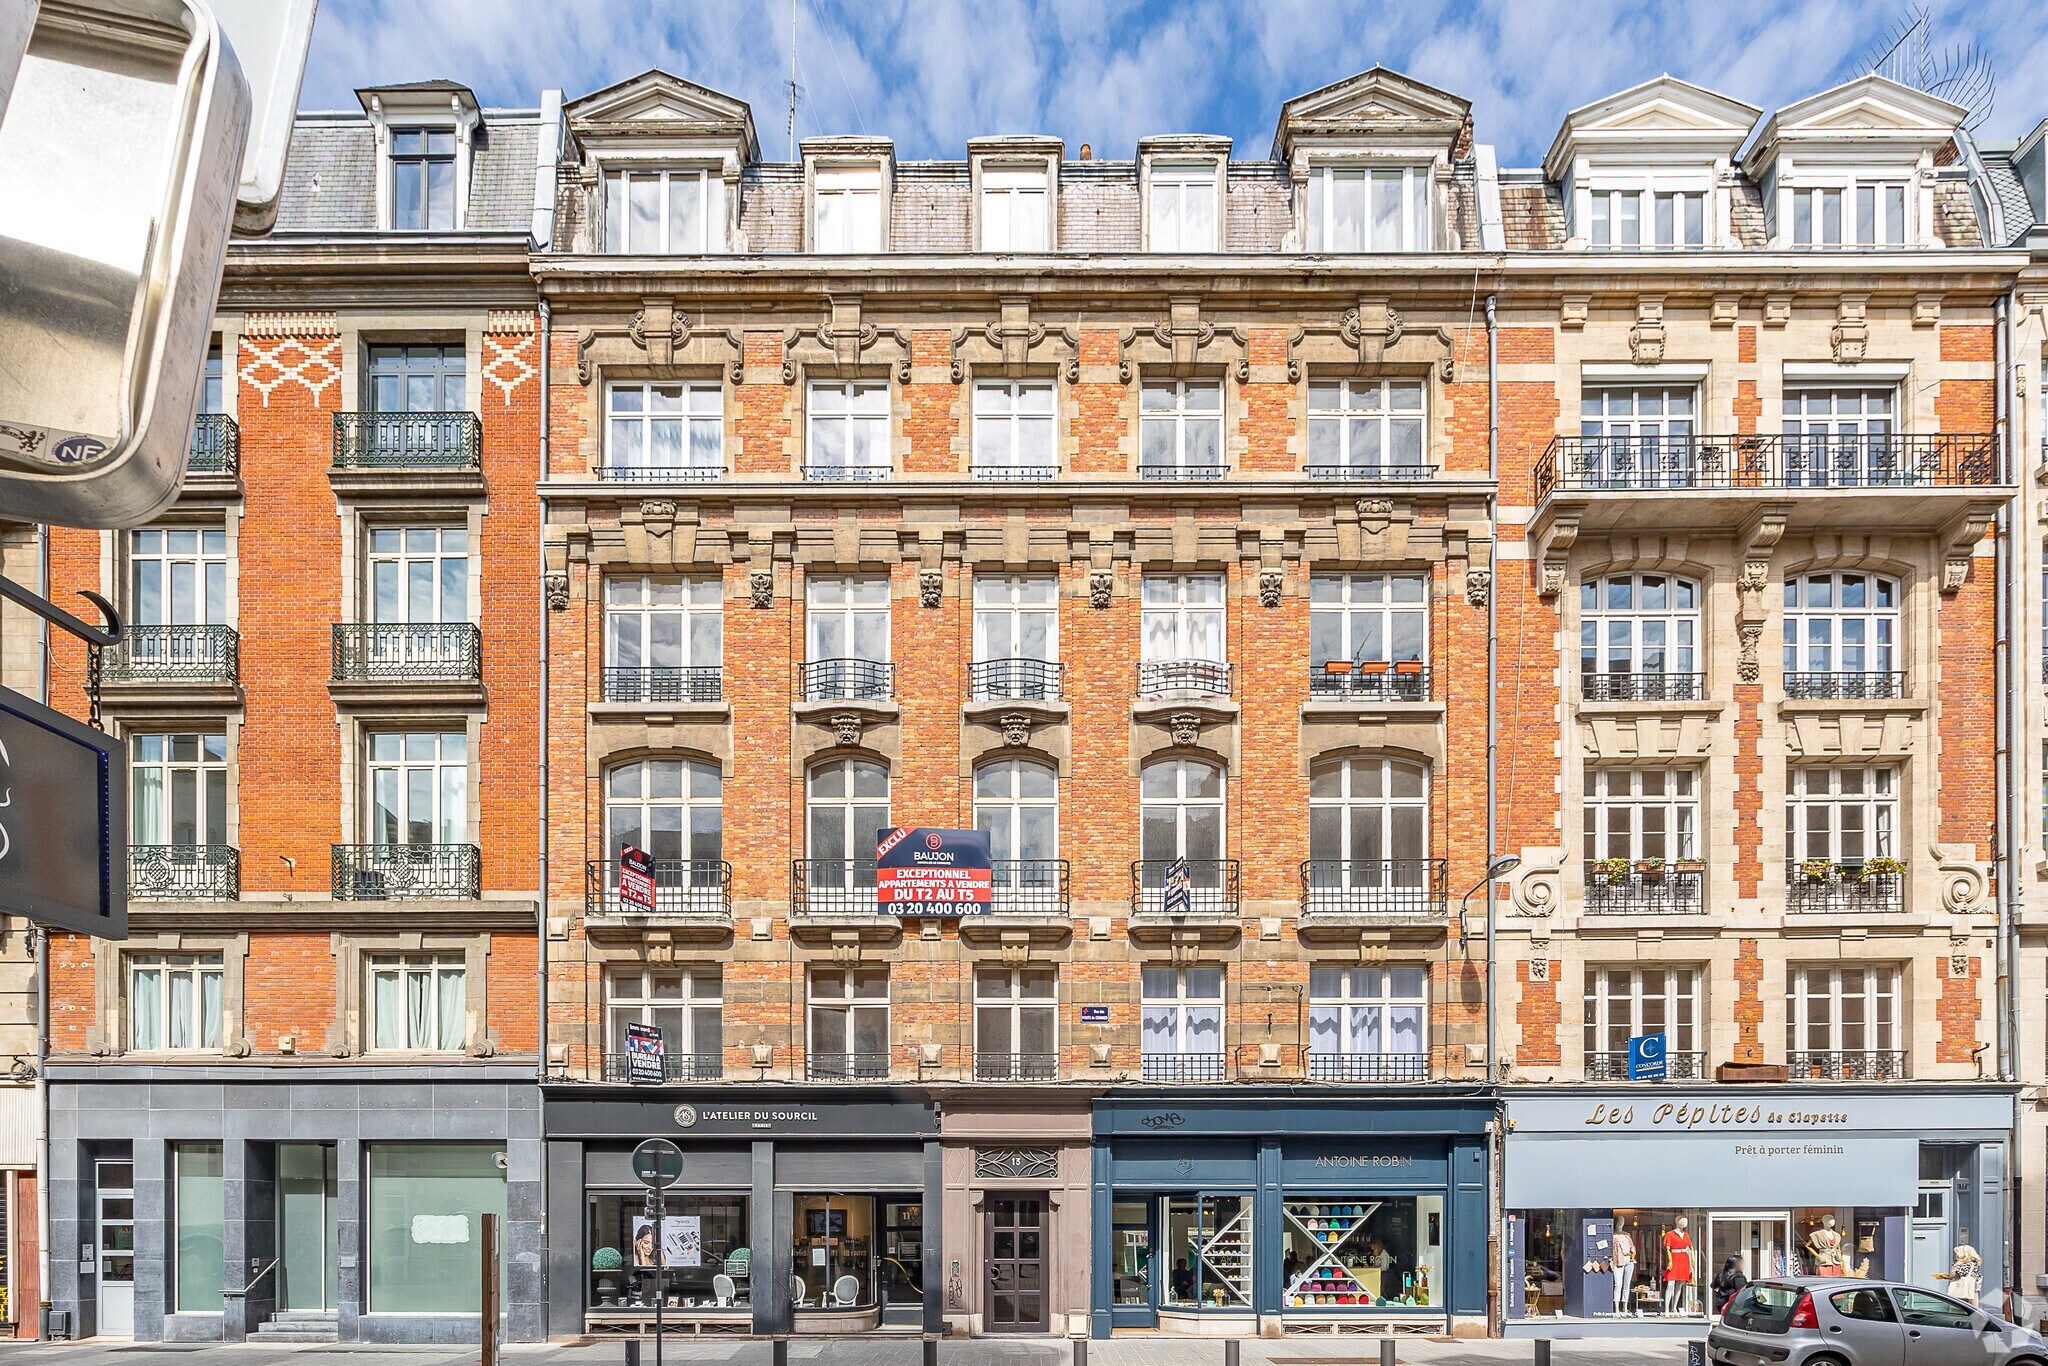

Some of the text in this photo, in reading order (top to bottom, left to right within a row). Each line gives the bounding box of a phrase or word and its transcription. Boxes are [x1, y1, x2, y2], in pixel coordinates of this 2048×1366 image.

[61, 445, 102, 460] NF
[878, 828, 907, 856] EXCLU
[914, 852, 954, 861] BAUJON
[897, 869, 971, 879] EXCEPTIONNEL
[879, 880, 990, 889] APPARTEMENTS A VENDRE
[894, 889, 974, 901] DU T2 AU T5
[888, 903, 981, 914] 03 20 400 600
[1639, 1037, 1659, 1058] C
[632, 1059, 661, 1070] VENDRE
[702, 1111, 818, 1120] L'ATELIER DU SOURCIL
[1585, 1102, 1848, 1129] Les Pépites de Clapette
[1734, 1145, 1844, 1157] Prêt à porter féminin
[1011, 1157, 1021, 1166] 13
[1315, 1156, 1412, 1167] ANTOINE ROBIN
[902, 1211, 910, 1220] 11
